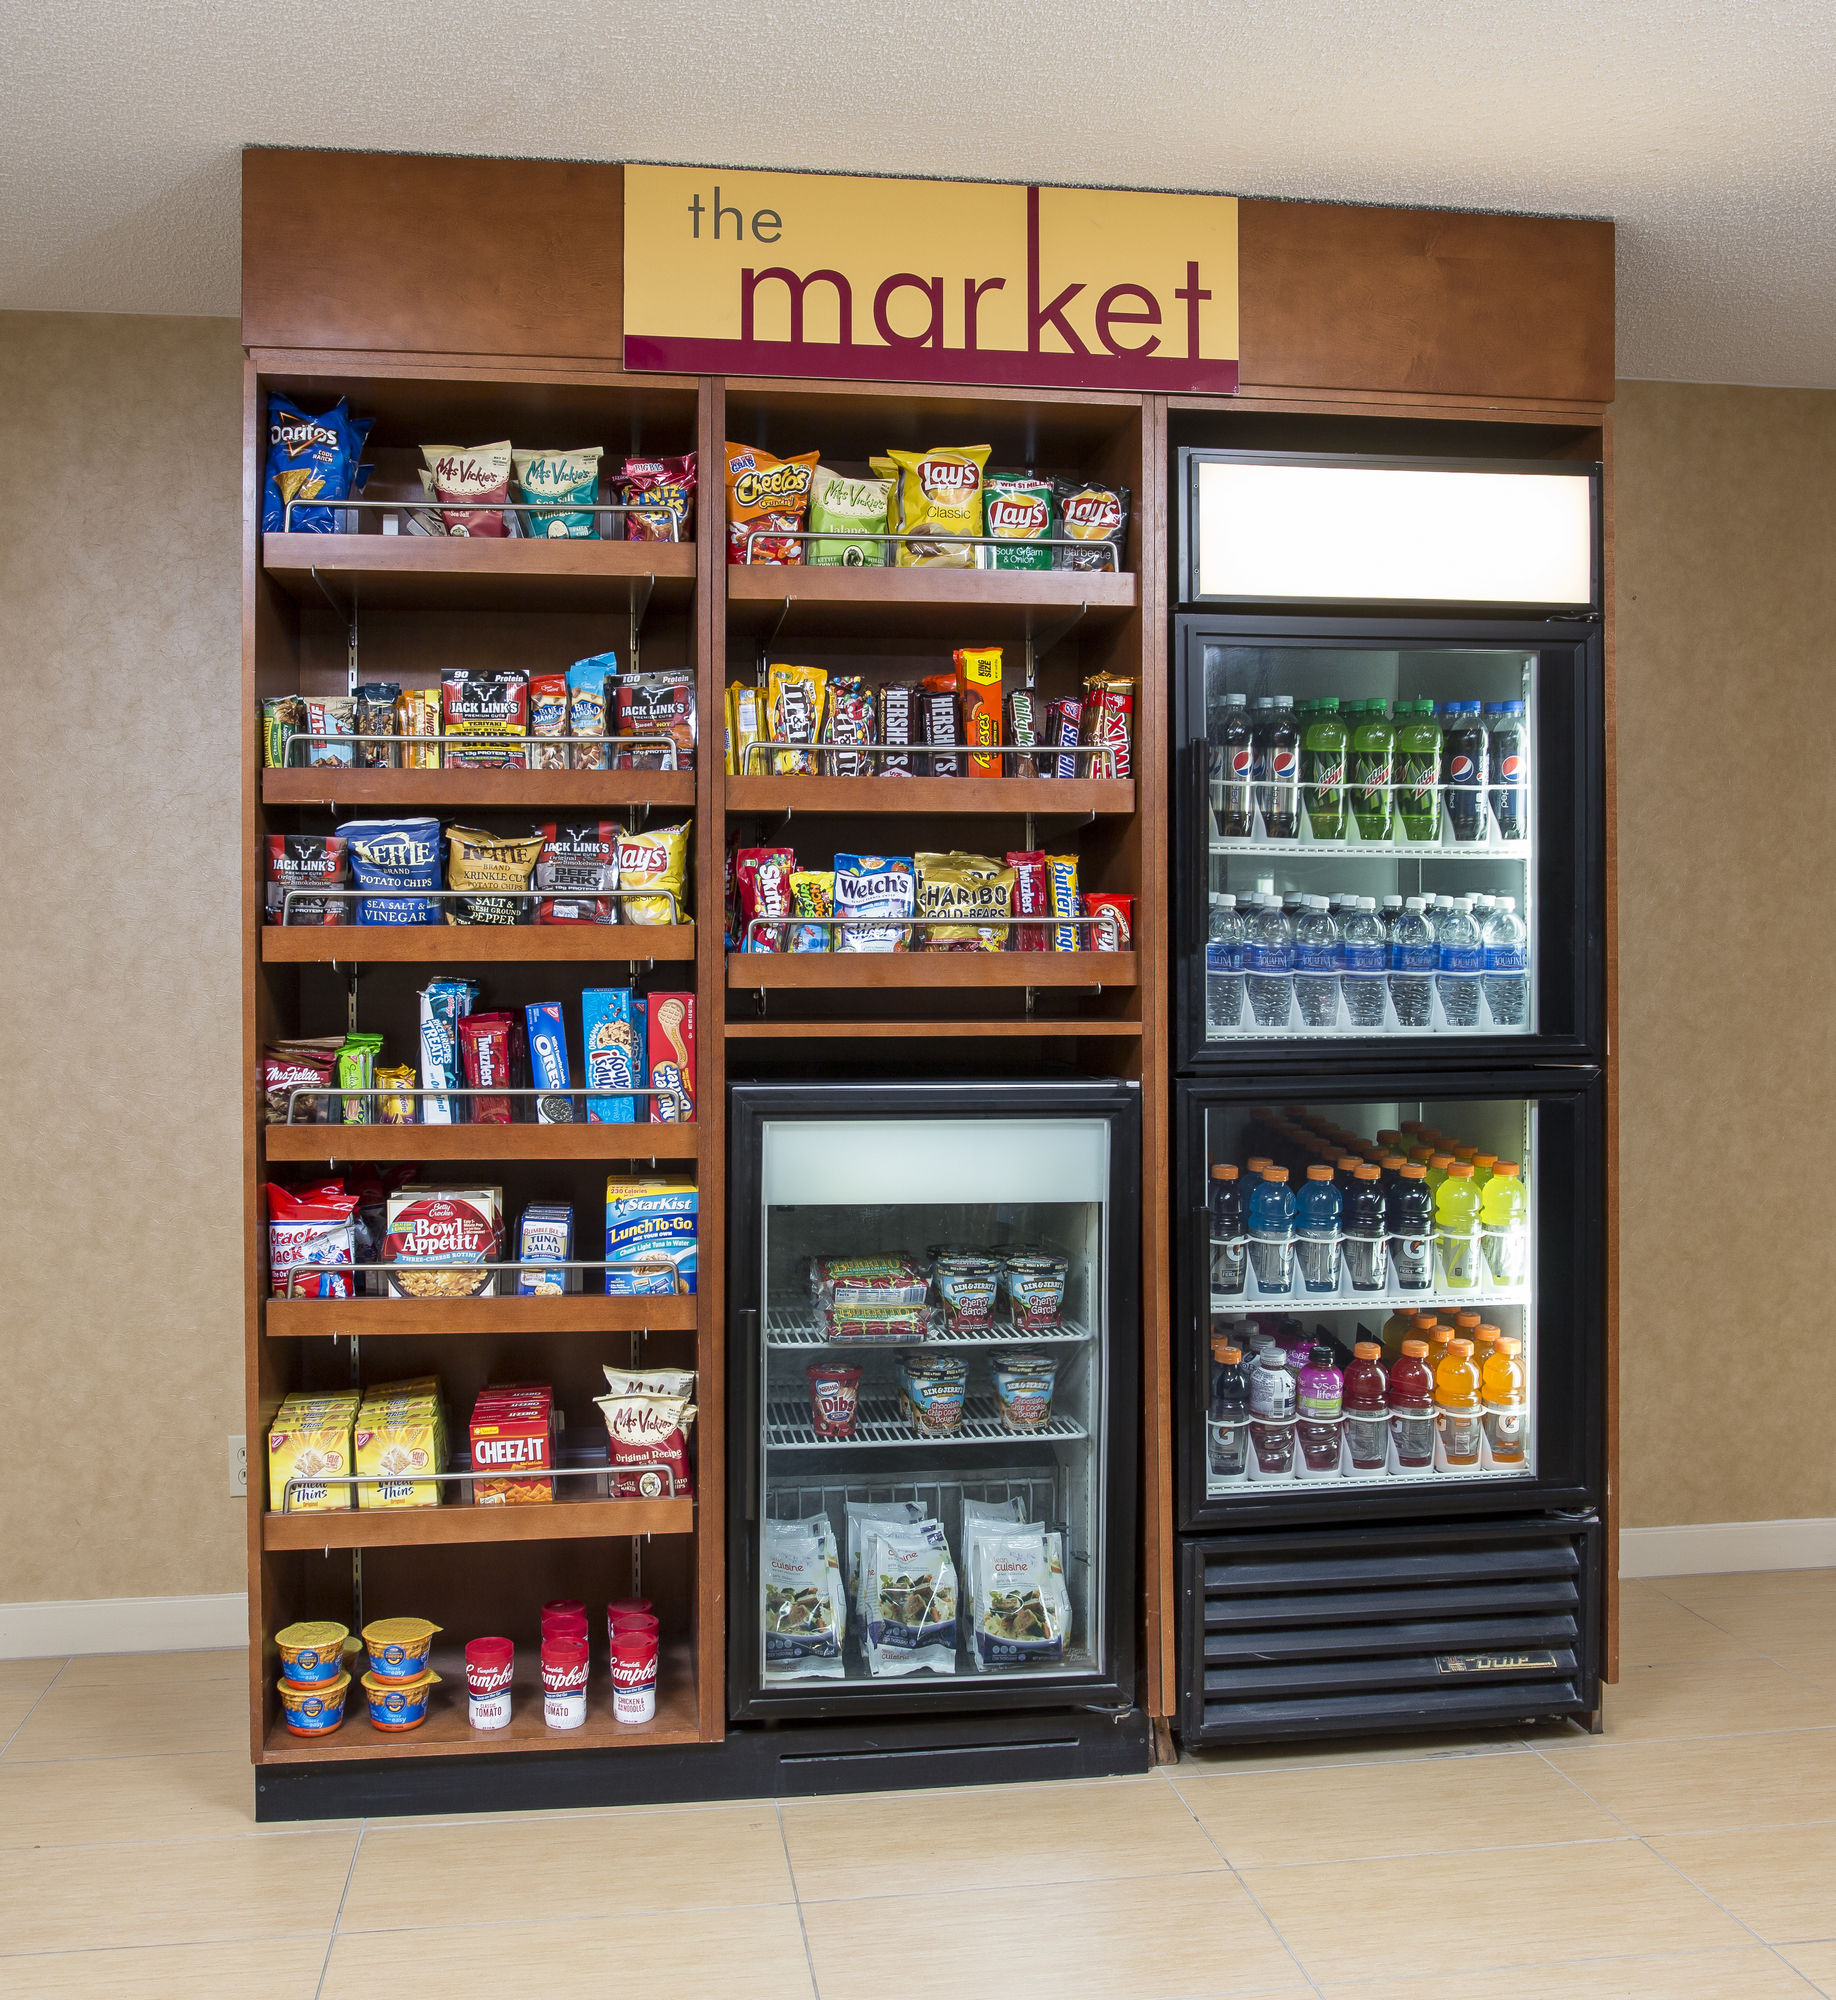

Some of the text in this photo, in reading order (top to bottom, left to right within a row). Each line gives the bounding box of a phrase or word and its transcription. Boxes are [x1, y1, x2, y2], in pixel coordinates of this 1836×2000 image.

[687, 186, 783, 244] the
[741, 186, 1212, 360] market
[271, 424, 338, 446] Doritos
[459, 458, 499, 488] Vickie's
[551, 459, 591, 485] Vickie's
[731, 459, 756, 473] GRAB
[924, 461, 976, 491] Lay's
[738, 466, 809, 505] Cheetos
[759, 495, 795, 510] Crunchy
[926, 505, 971, 520] Classic
[993, 501, 1044, 529] Lay's
[1064, 500, 1120, 528] Lay's
[1010, 554, 1035, 565] Onion
[453, 670, 469, 679] 90
[977, 659, 985, 677] KING
[494, 674, 524, 683] Protein
[622, 675, 641, 683] 100
[662, 675, 690, 684] Protein
[450, 701, 519, 714] JACK LINK'S
[573, 702, 594, 713] BLUE
[621, 702, 685, 718] JACK LINK'S
[1012, 696, 1033, 730] Milky
[886, 690, 909, 766] HERSHE'S
[930, 697, 957, 772] HERSHY'S
[972, 712, 991, 770] Rese's
[352, 831, 435, 867] KETTLE
[543, 842, 610, 854] JACK LINK'S
[273, 859, 336, 872] JACK LINK'S
[483, 863, 511, 871] BRAND
[555, 867, 598, 877] BEEF
[359, 875, 432, 888] POTATO CHIPS
[467, 881, 523, 891] POTATO CHIPS
[549, 875, 601, 885] JERKY
[840, 874, 909, 900] Welch's
[926, 884, 1009, 908] HARIBO
[1017, 863, 1035, 915] Twizzlers
[366, 899, 426, 911] SEA SALT &
[475, 897, 514, 909] SALT &
[799, 882, 811, 918] SOUR
[810, 882, 823, 918] PATCH
[364, 909, 428, 923] VINEGAR
[467, 905, 522, 917] FRESH GROUND
[926, 907, 1006, 918] GOLD-BEARS
[471, 911, 516, 926] PEPPER
[431, 1019, 453, 1064] RICE KRISPIES
[587, 1020, 604, 1050] ORIGINAL
[421, 1020, 445, 1067] TREATS
[477, 1033, 494, 1088] Twizzlers
[624, 1187, 648, 1195] Calories
[433, 1202, 452, 1213] Betty
[627, 1196, 692, 1212] StarKist
[428, 1208, 454, 1218] Crocker
[414, 1218, 465, 1239] Bowl
[609, 1220, 654, 1244] Lunch
[530, 1234, 558, 1245] TUNA
[642, 1233, 658, 1241] YOUR
[402, 1233, 479, 1256] Appétit!
[527, 1243, 561, 1254] SALAD
[619, 1246, 637, 1257] Chunk
[637, 1242, 652, 1252] Light
[652, 1240, 666, 1248] Tuna
[672, 1238, 690, 1247] Water
[271, 1245, 304, 1264] Jack
[451, 1251, 477, 1261] ROTINI
[960, 1296, 989, 1308] Cherry
[1029, 1296, 1059, 1307] Cherry
[961, 1305, 989, 1317] Garcia
[1031, 1305, 1057, 1316] Garcia
[822, 1395, 855, 1413] Dibs
[935, 1415, 955, 1423] Dough
[474, 1437, 545, 1465] CHEEZ-IT
[615, 1447, 683, 1464] Original Recipe
[291, 1486, 328, 1503] Thins
[377, 1484, 415, 1500] Thins
[771, 1559, 805, 1573] cuisine
[994, 1560, 1029, 1572] cuisine
[304, 1673, 320, 1682] easy
[392, 1668, 407, 1677] easy
[617, 1696, 640, 1705] CHICKEN
[475, 1706, 502, 1717] TOMATO
[545, 1705, 569, 1717] TOMATO
[623, 1704, 646, 1713] NOODLES
[308, 1720, 324, 1729] easy
[391, 1716, 407, 1724] easy
